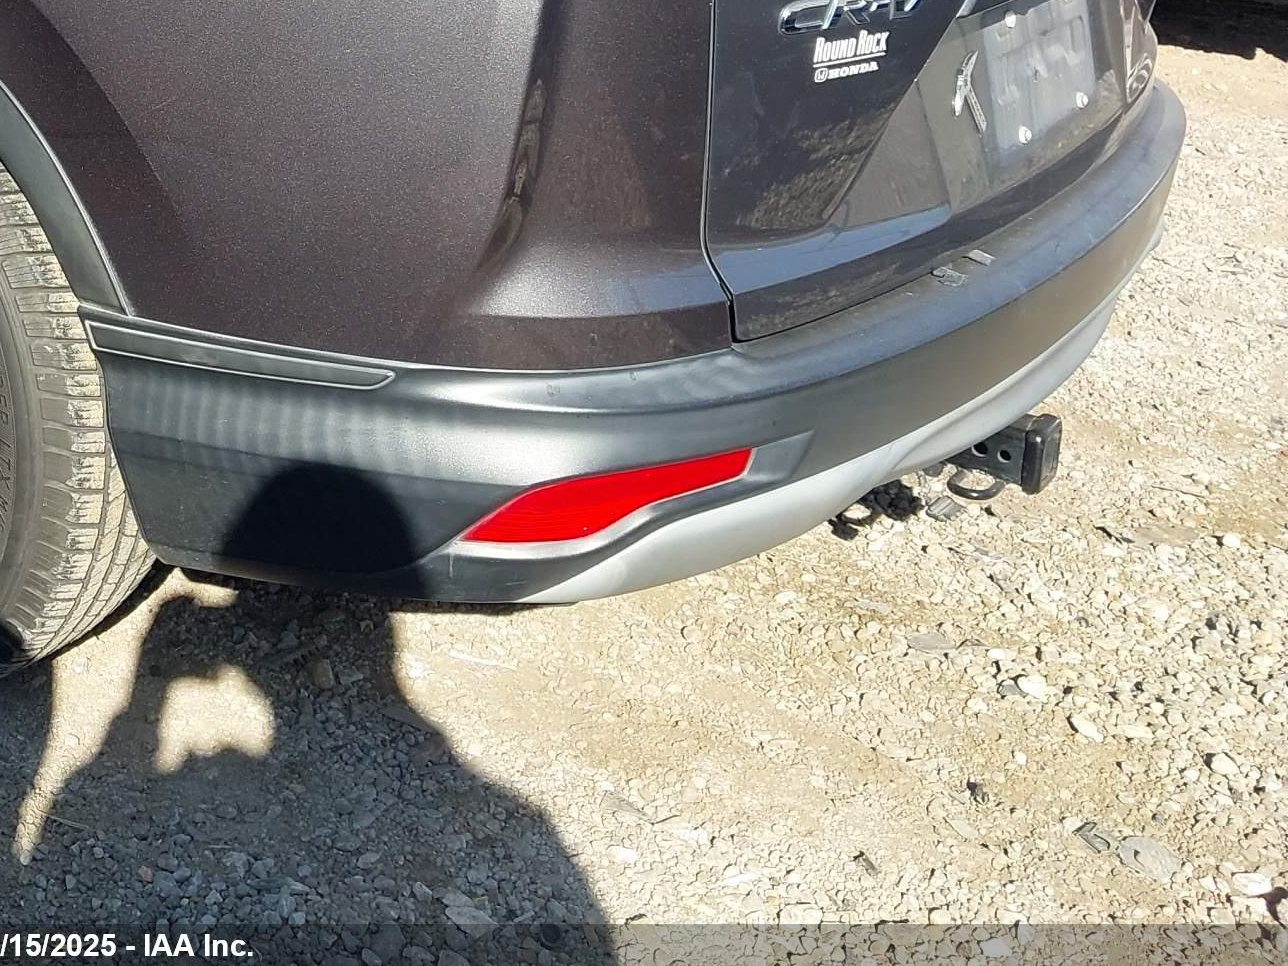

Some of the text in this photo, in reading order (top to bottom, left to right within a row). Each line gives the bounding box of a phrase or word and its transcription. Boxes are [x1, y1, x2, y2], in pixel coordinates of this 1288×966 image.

[813, 29, 891, 64] ROUND ROCK
[827, 61, 880, 80] HONDA
